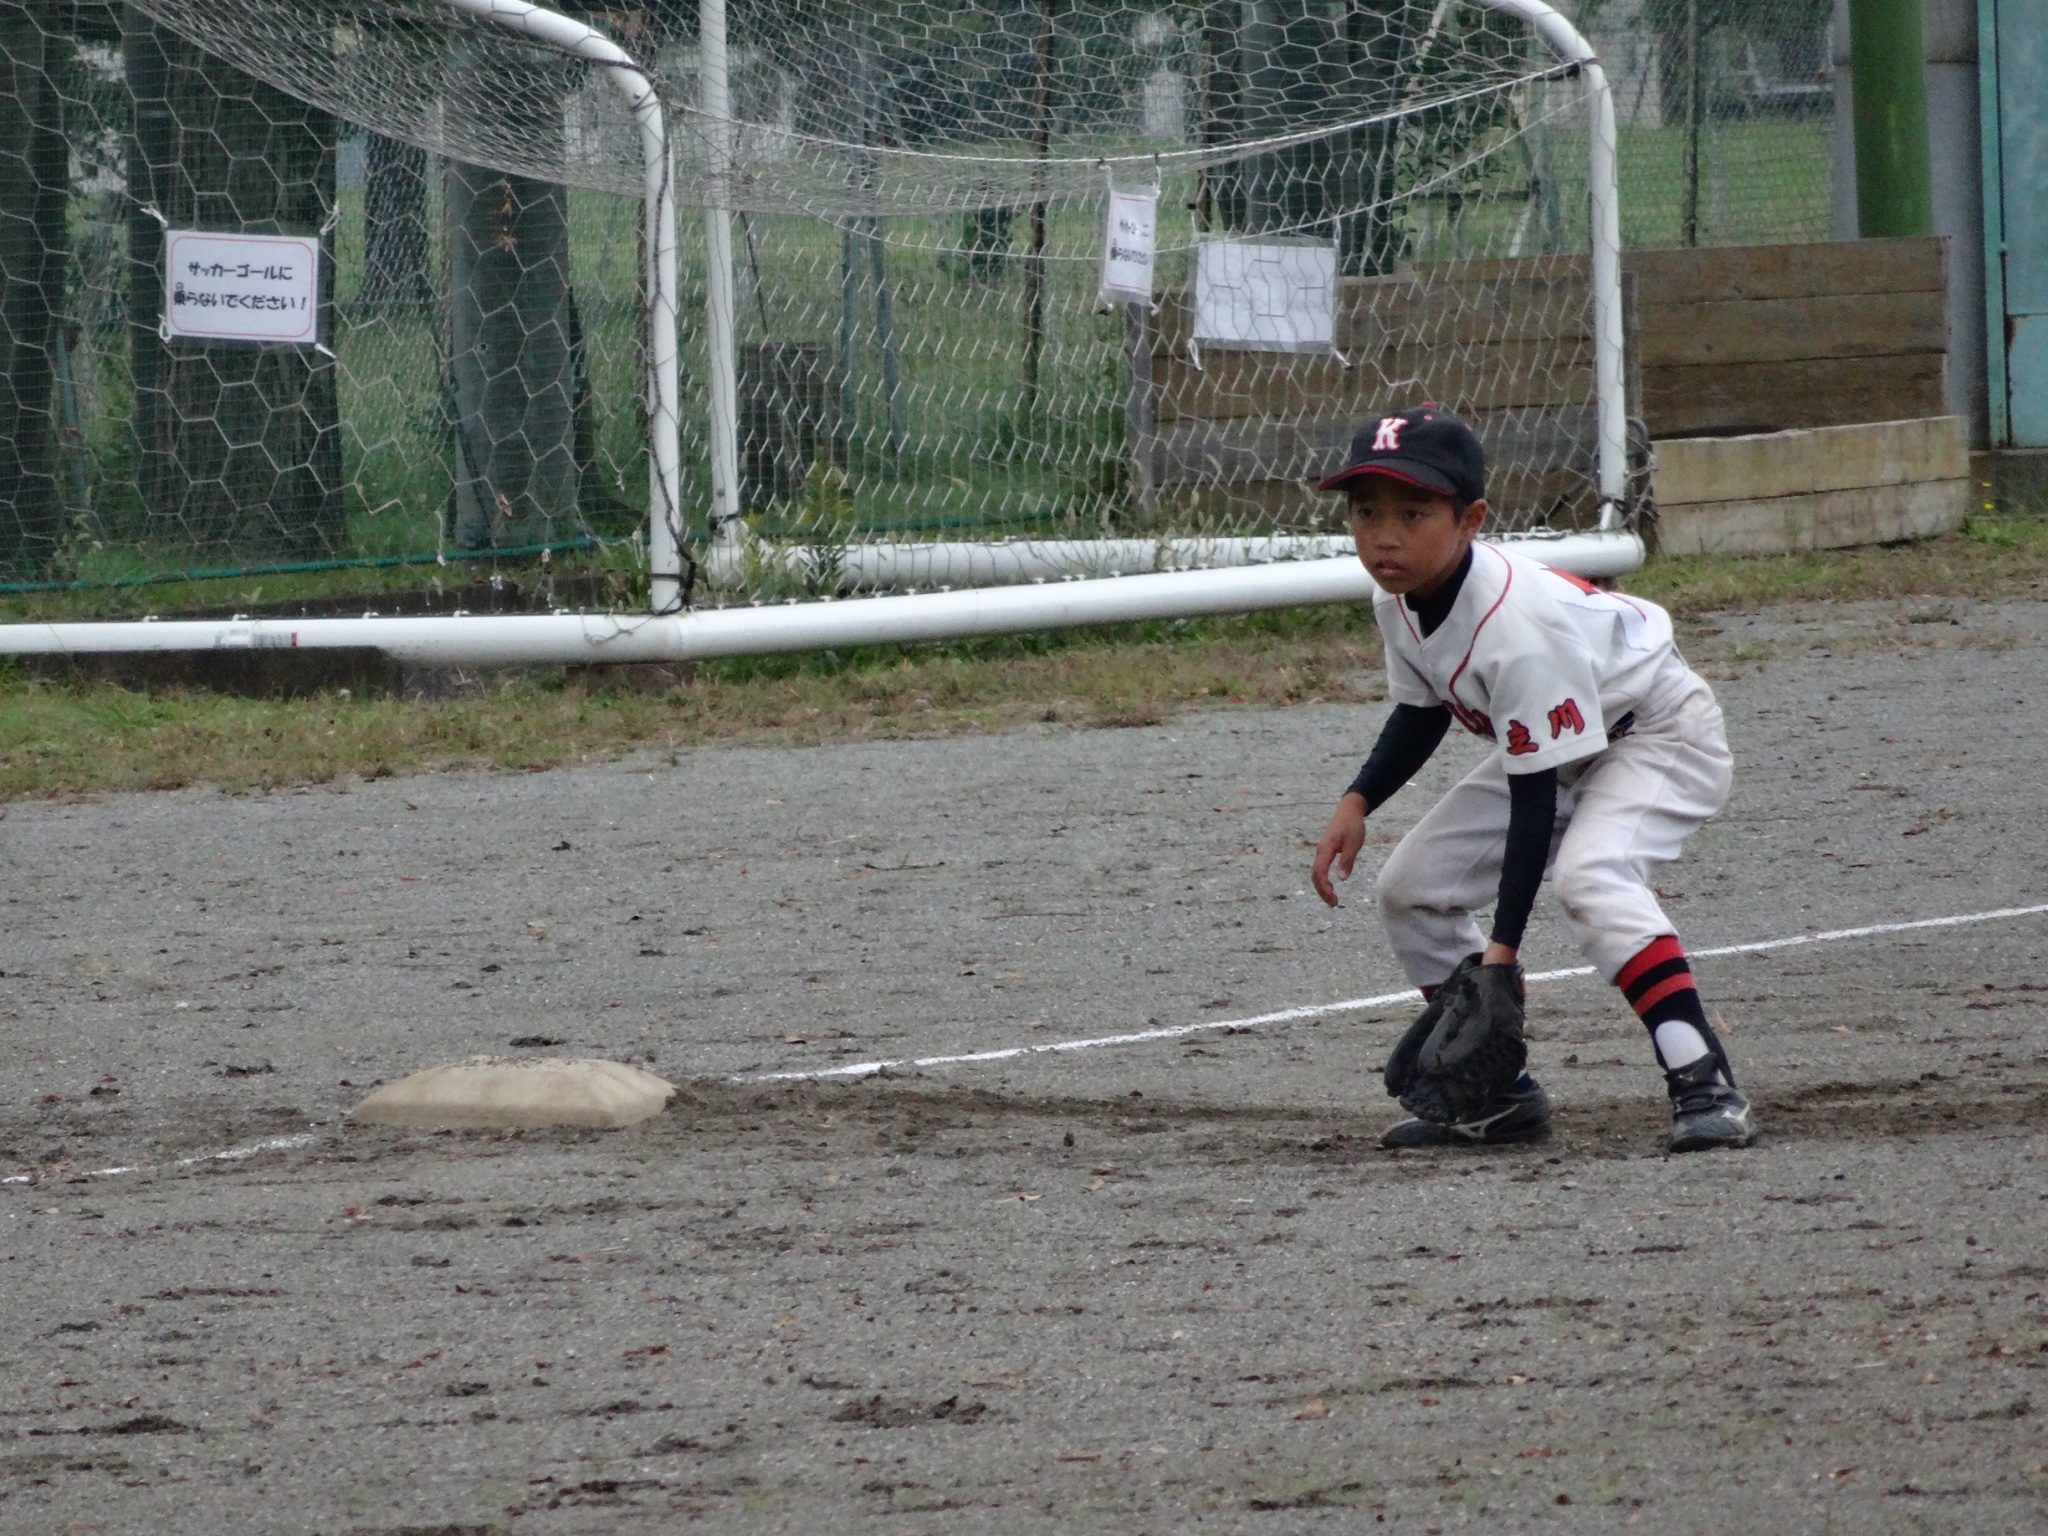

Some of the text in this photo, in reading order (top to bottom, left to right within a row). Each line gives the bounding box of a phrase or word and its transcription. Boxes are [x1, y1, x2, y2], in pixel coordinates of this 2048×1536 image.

[188, 261, 292, 280] サッカーゴールに
[1371, 417, 1409, 452] K
